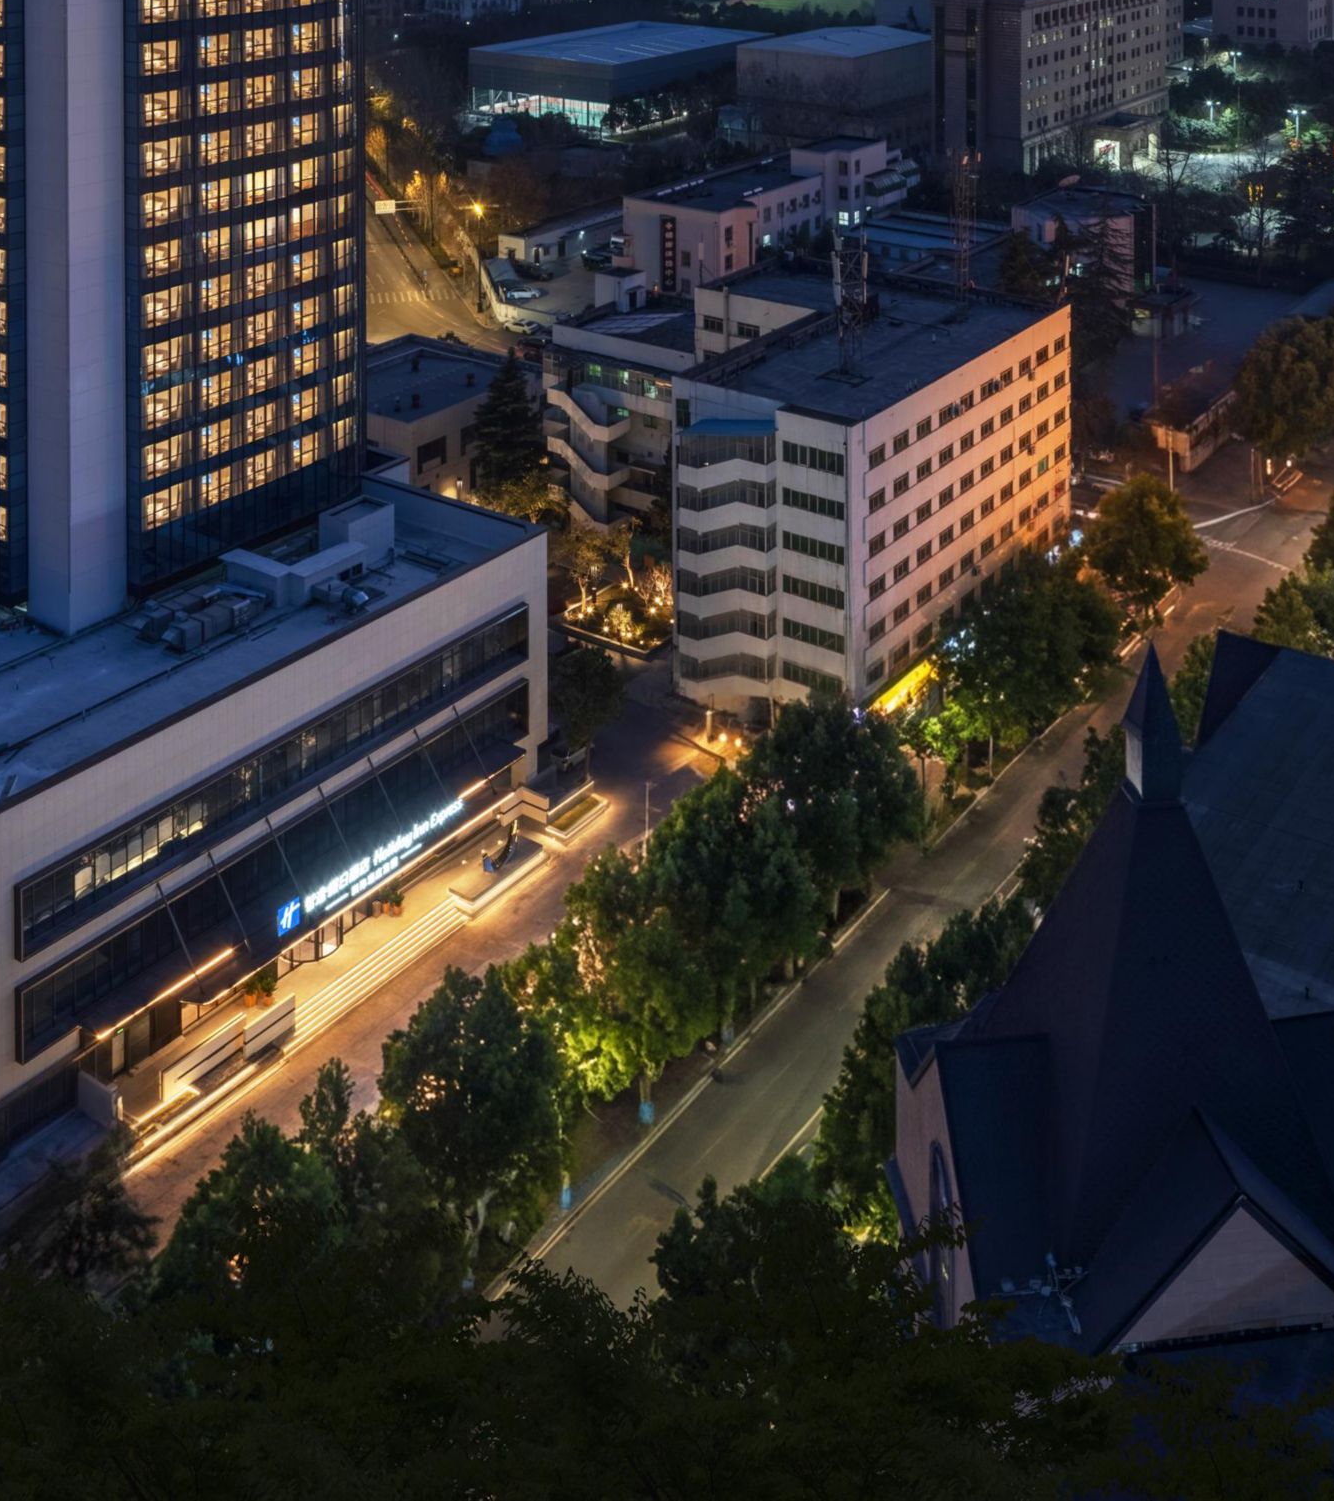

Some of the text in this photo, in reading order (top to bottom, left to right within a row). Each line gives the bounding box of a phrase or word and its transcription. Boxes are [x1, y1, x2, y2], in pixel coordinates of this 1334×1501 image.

[373, 798, 463, 866] Holiday Inn Express
